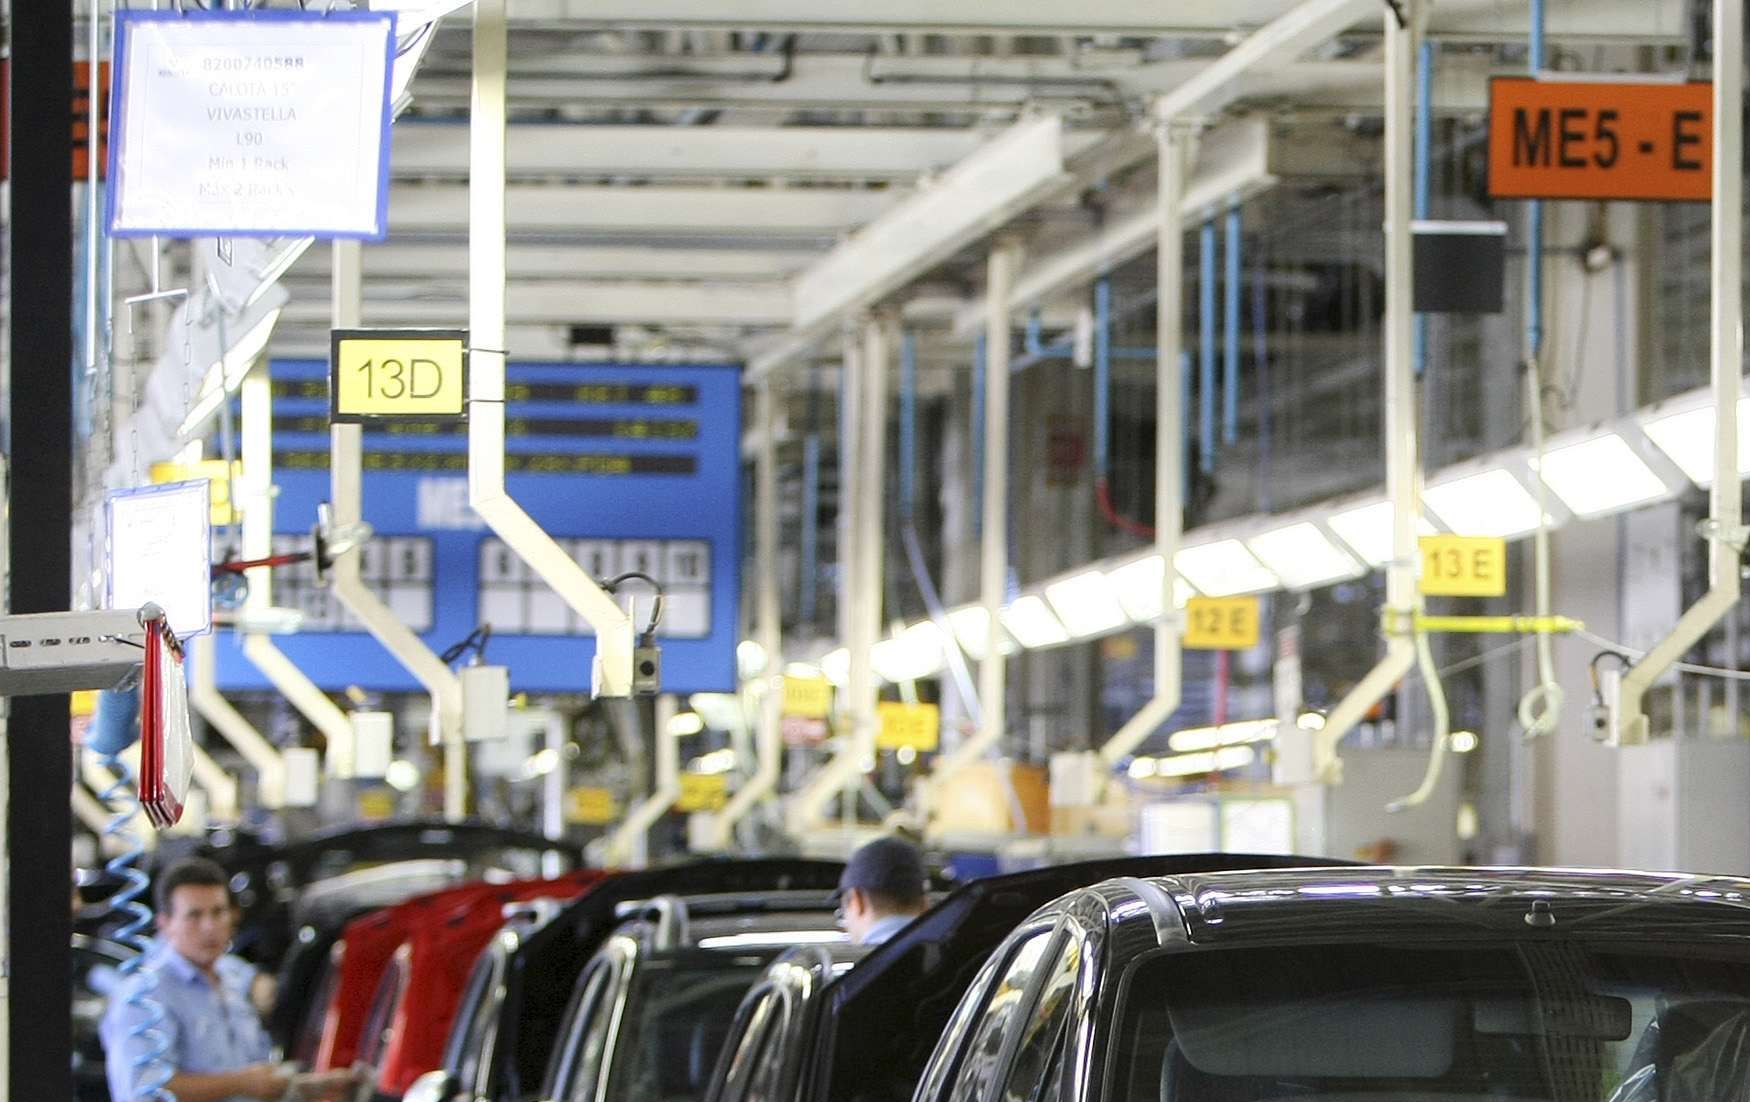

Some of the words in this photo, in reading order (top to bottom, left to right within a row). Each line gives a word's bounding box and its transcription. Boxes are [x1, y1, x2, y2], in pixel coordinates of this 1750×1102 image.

[207, 106, 297, 121] VIVASTELLA
[1513, 108, 1620, 169] ME5
[1672, 111, 1702, 170] E
[357, 359, 443, 399] 13D
